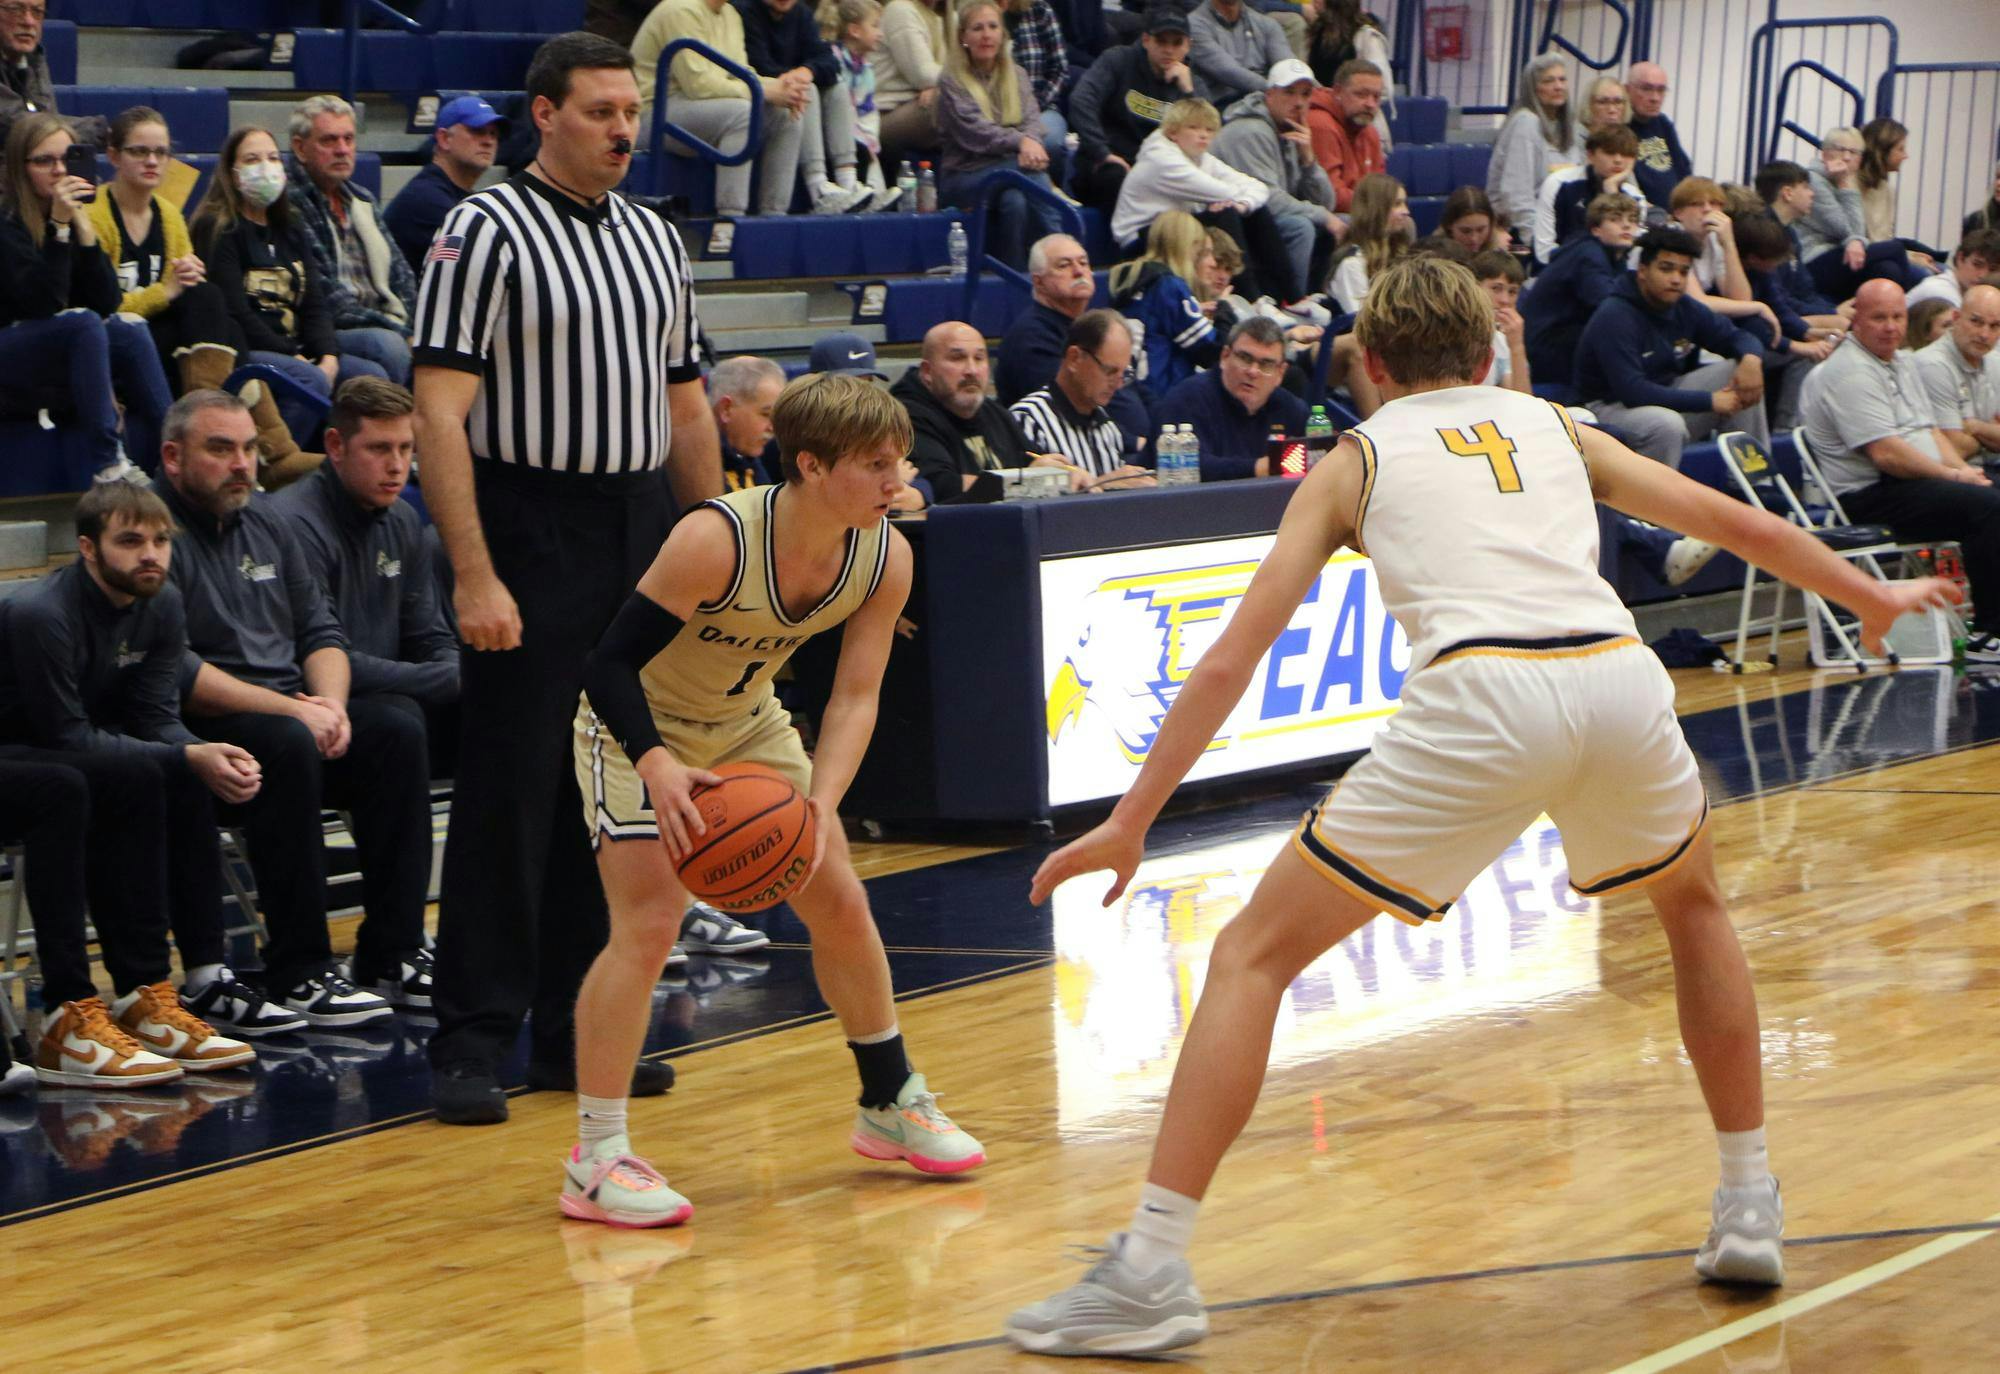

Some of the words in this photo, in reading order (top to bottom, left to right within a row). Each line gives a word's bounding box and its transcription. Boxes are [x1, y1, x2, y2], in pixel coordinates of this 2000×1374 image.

[1434, 419, 1525, 494] 4
[725, 660, 767, 697] 1
[702, 827, 783, 886] EVOLUTION
[722, 856, 807, 909] Wilson
